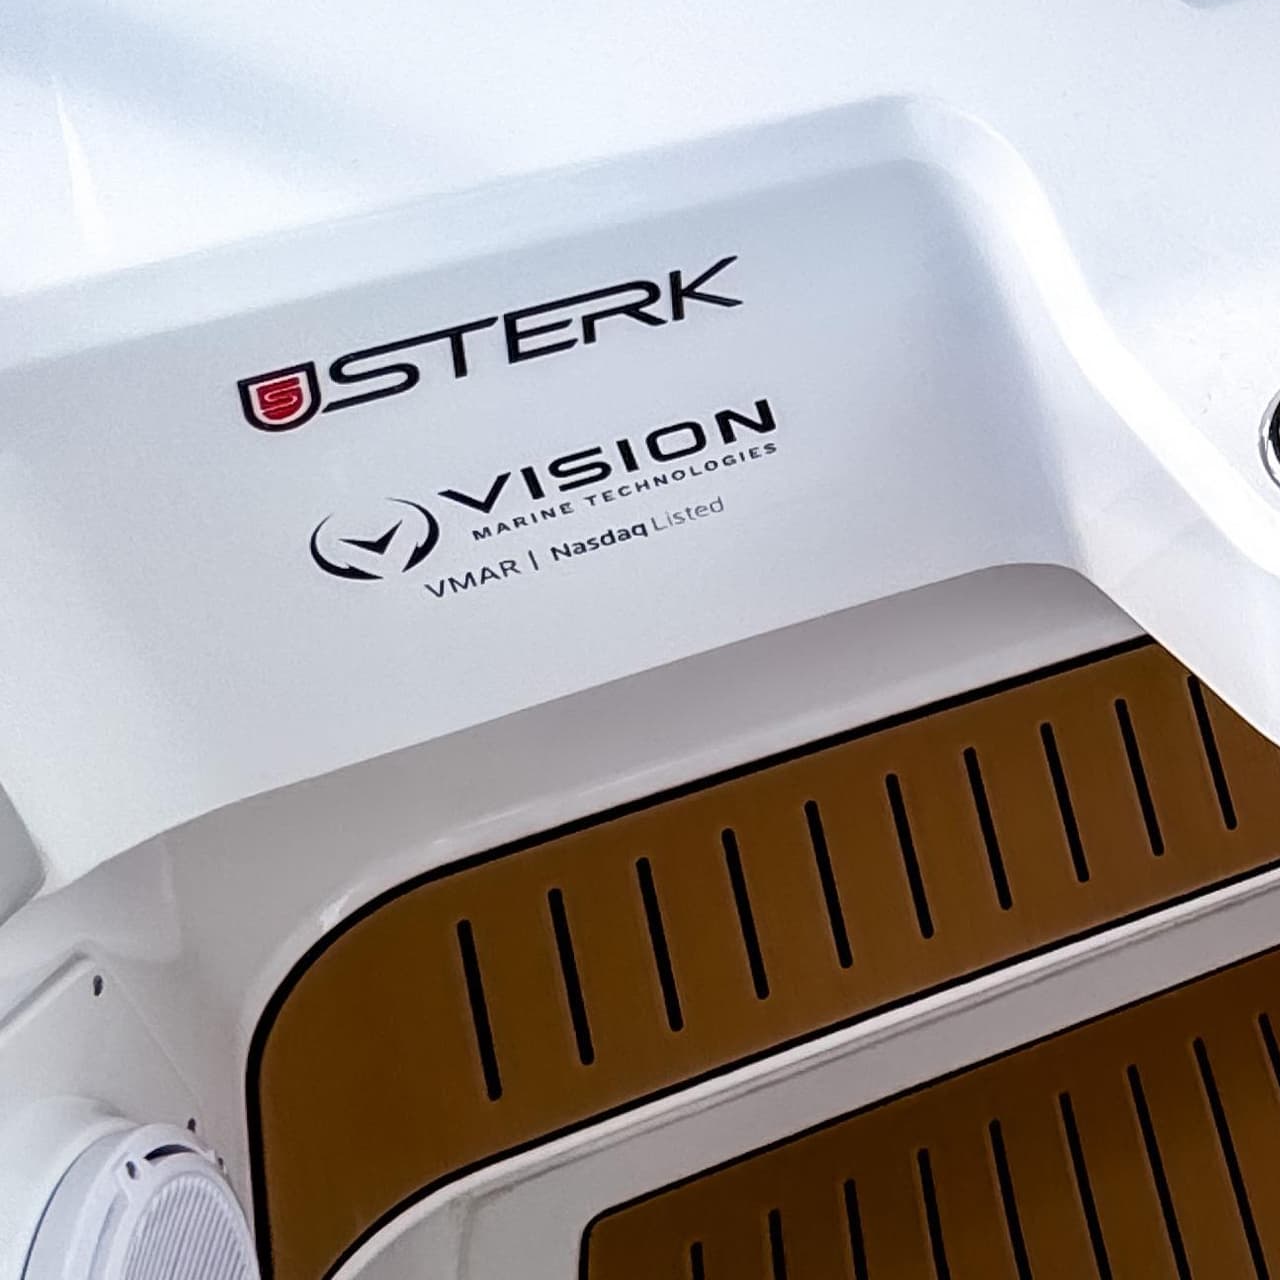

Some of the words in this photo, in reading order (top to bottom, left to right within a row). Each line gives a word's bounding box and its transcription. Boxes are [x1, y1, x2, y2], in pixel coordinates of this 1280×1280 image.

[438, 399, 777, 514] VISION
[471, 501, 575, 542] MARINE
[584, 442, 779, 508] TECHNOLOGIES
[424, 558, 521, 599] VMAR
[550, 522, 650, 564] Nasdaq
[651, 495, 726, 533] Listed
